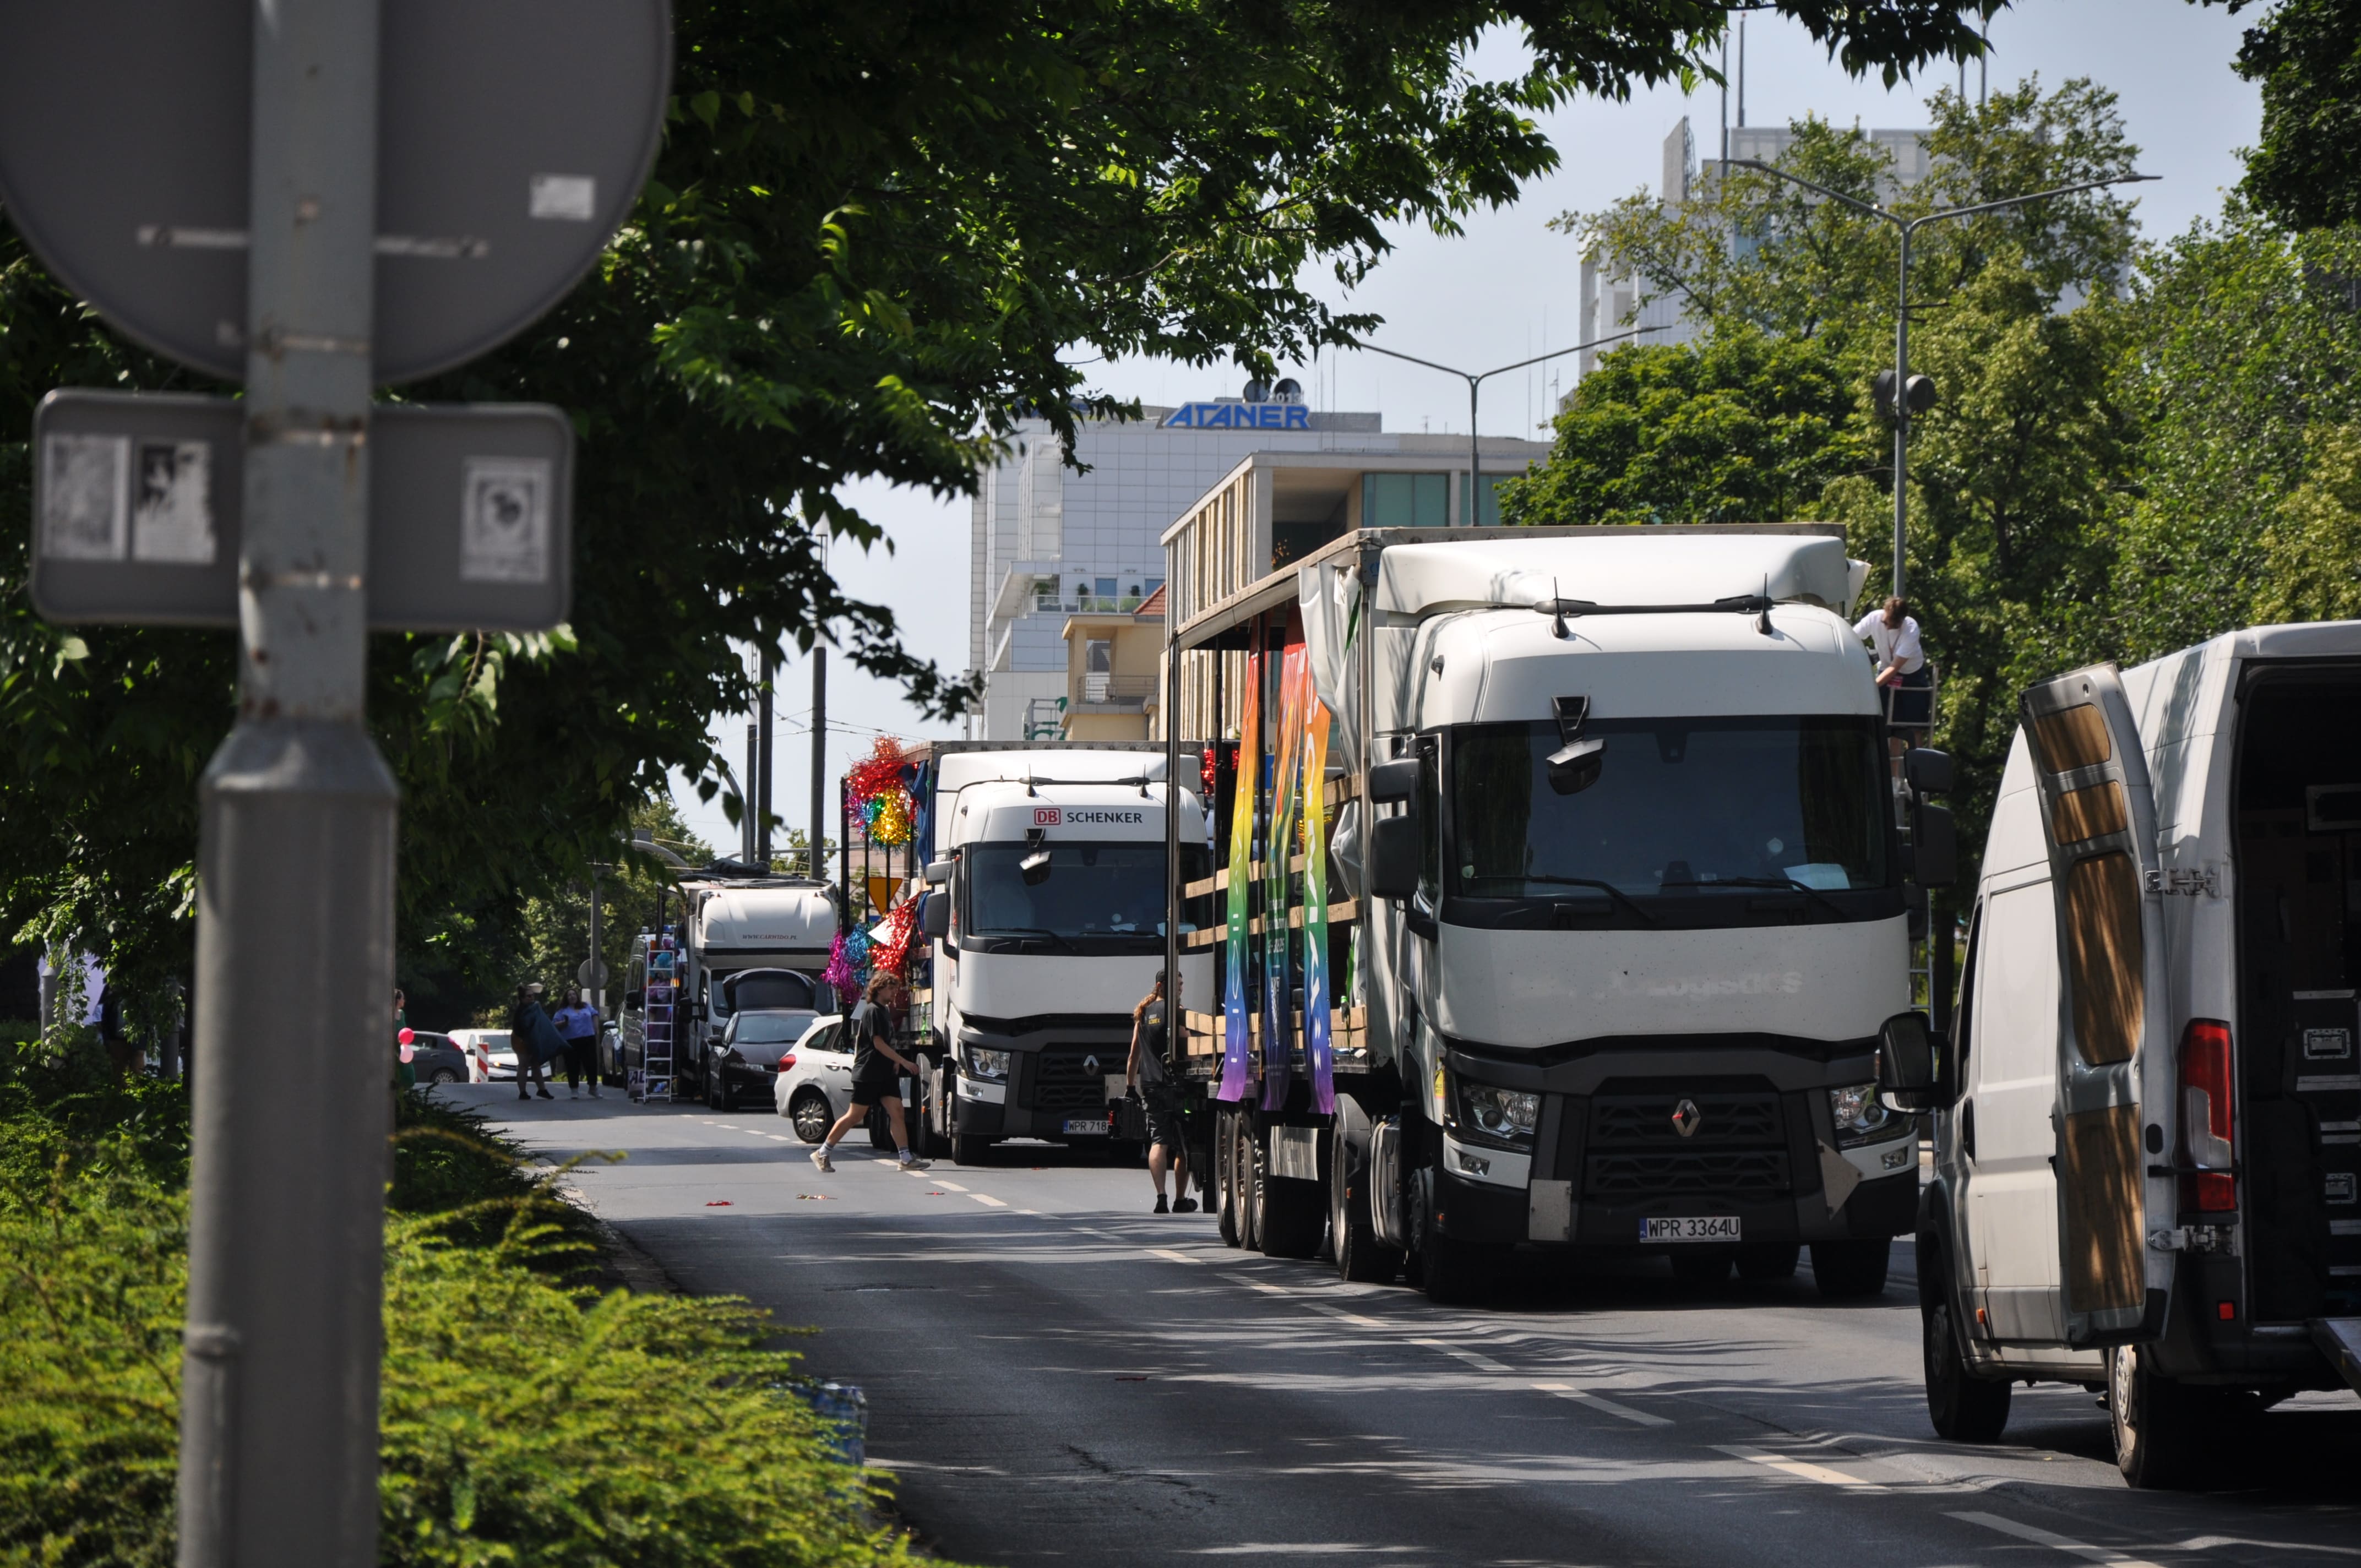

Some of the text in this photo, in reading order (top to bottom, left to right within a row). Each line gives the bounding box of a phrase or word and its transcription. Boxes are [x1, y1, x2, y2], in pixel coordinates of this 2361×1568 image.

[1165, 404, 1310, 428] ATANER
[1037, 810, 1143, 823] DB SCHENKER
[1069, 1121, 1086, 1131] WPR
[1649, 1218, 1738, 1237] WPR 3364U
